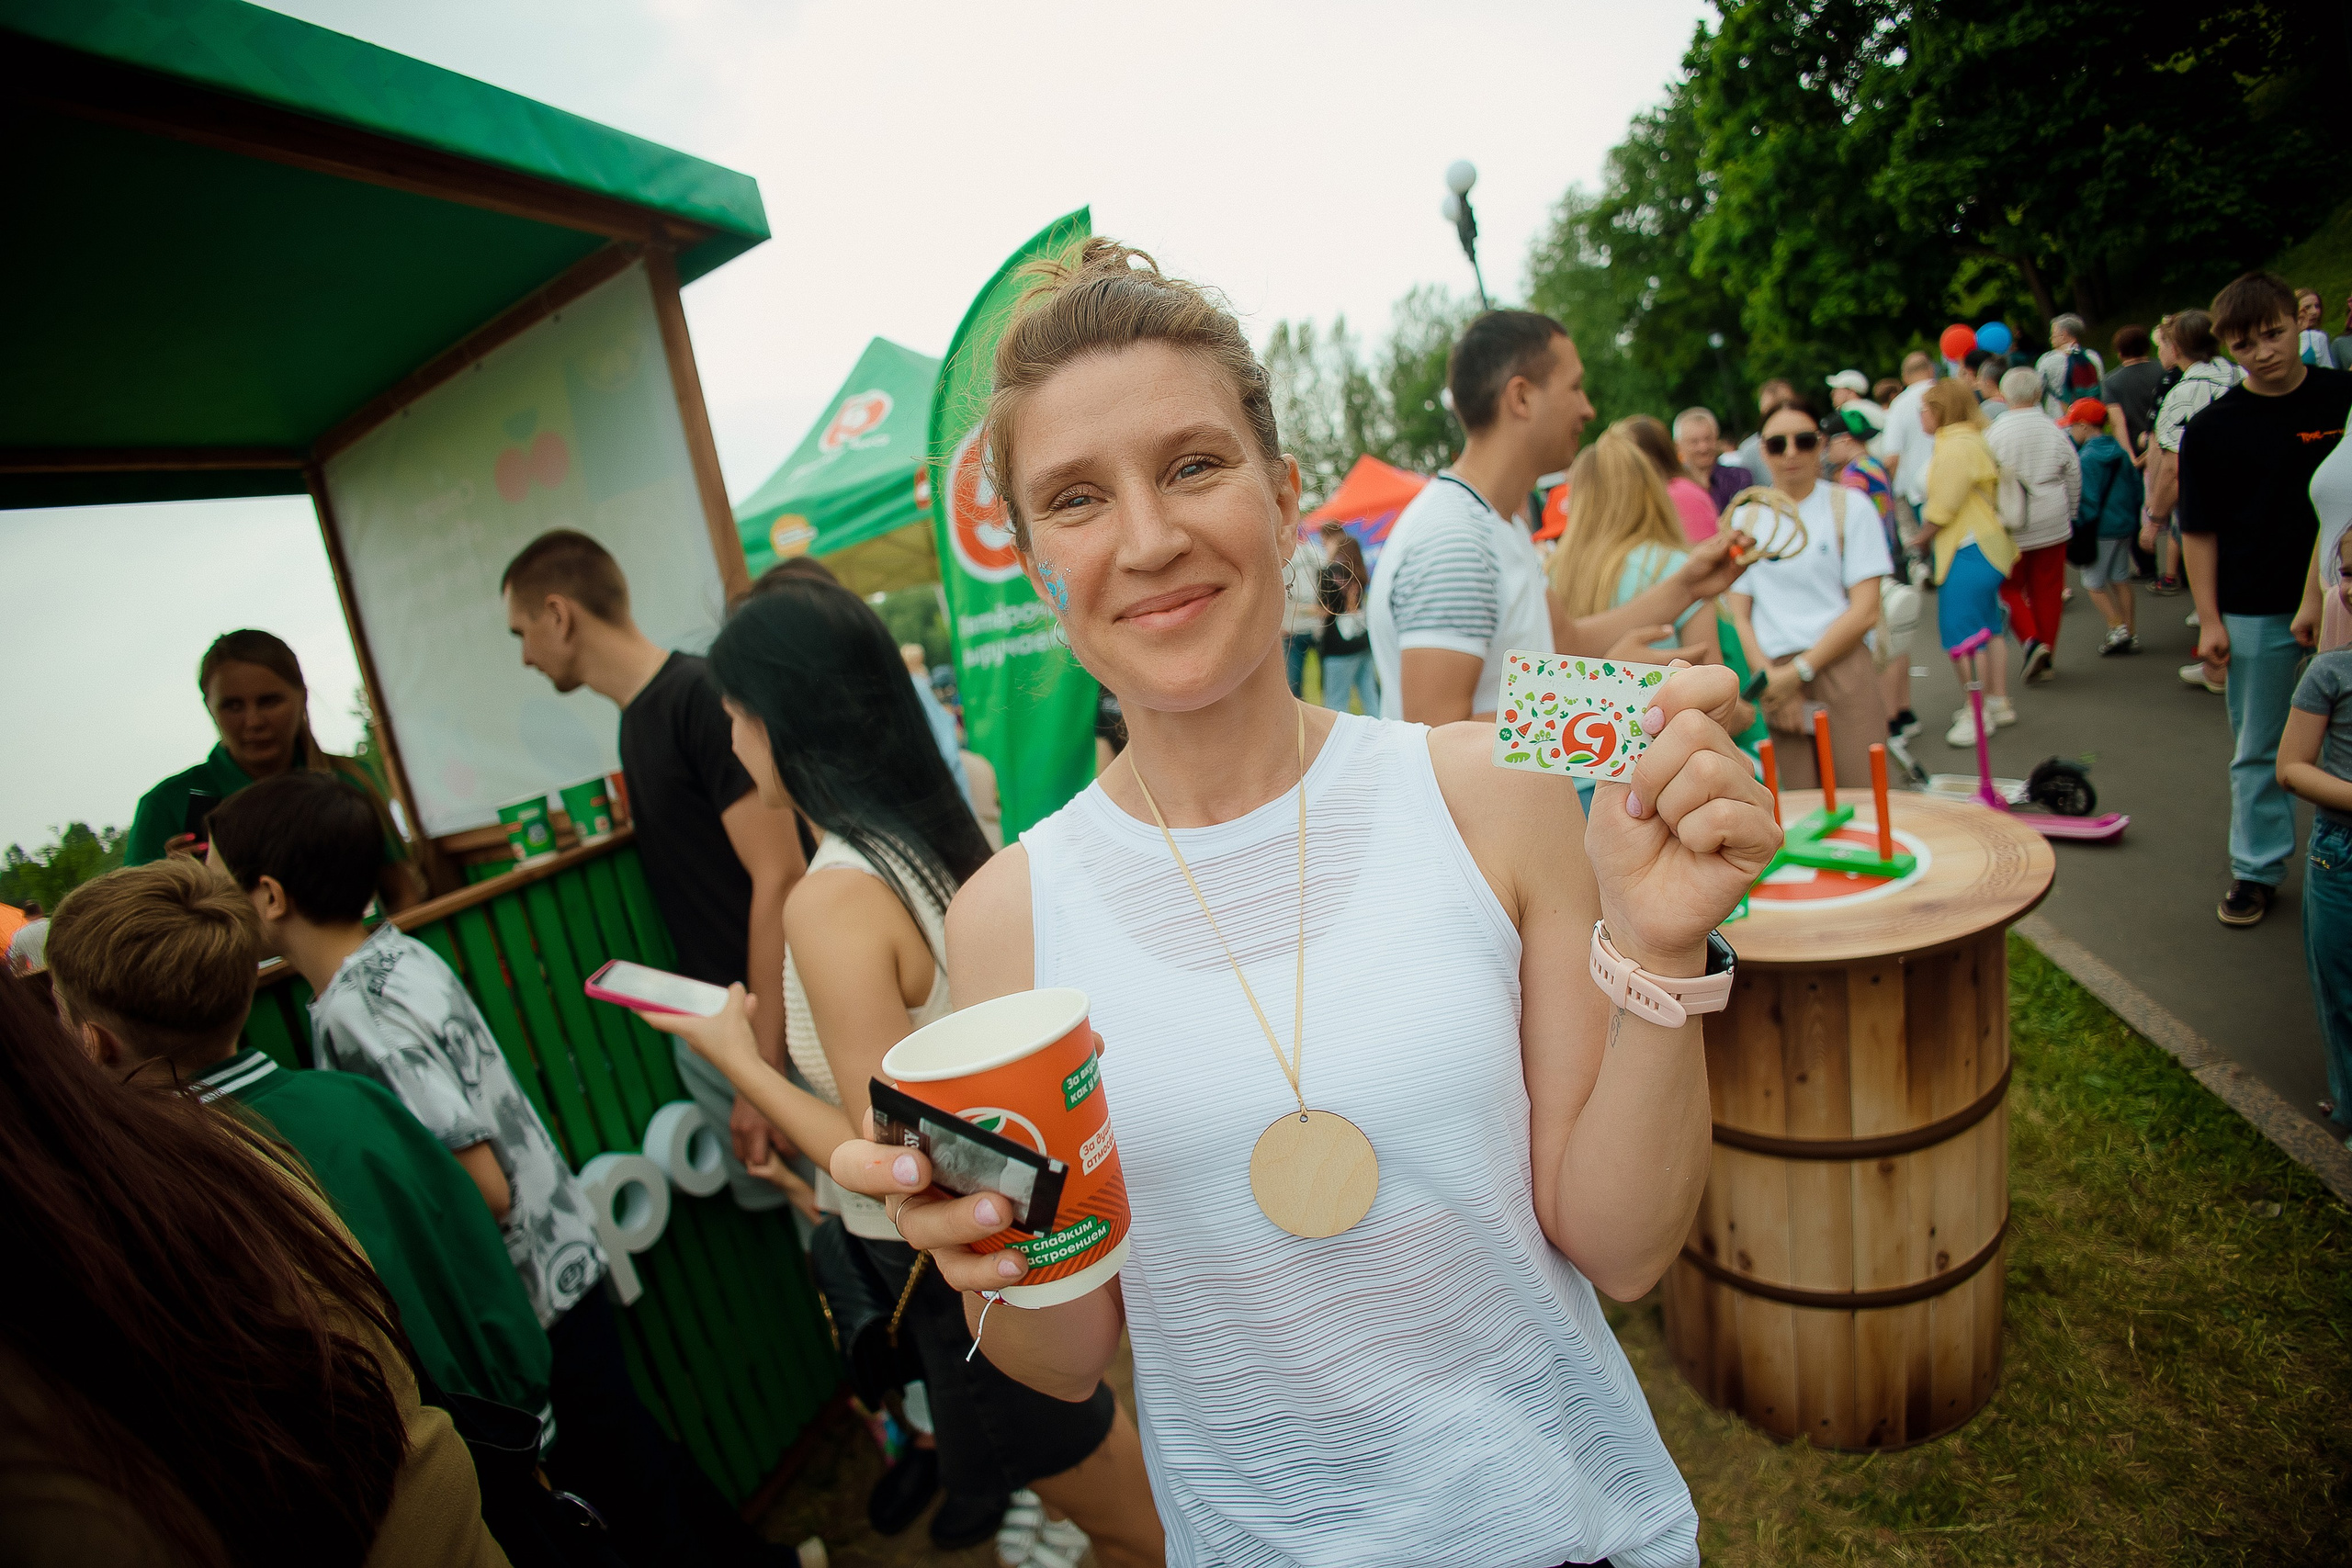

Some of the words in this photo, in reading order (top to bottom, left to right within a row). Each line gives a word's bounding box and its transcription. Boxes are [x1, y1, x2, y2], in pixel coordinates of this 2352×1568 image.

[1066, 1075, 1080, 1090] За
[1070, 1082, 1088, 1104] как
[1082, 1142, 1095, 1156] За
[1027, 1225, 1107, 1266] астроением
[1033, 1220, 1093, 1252] сладким
